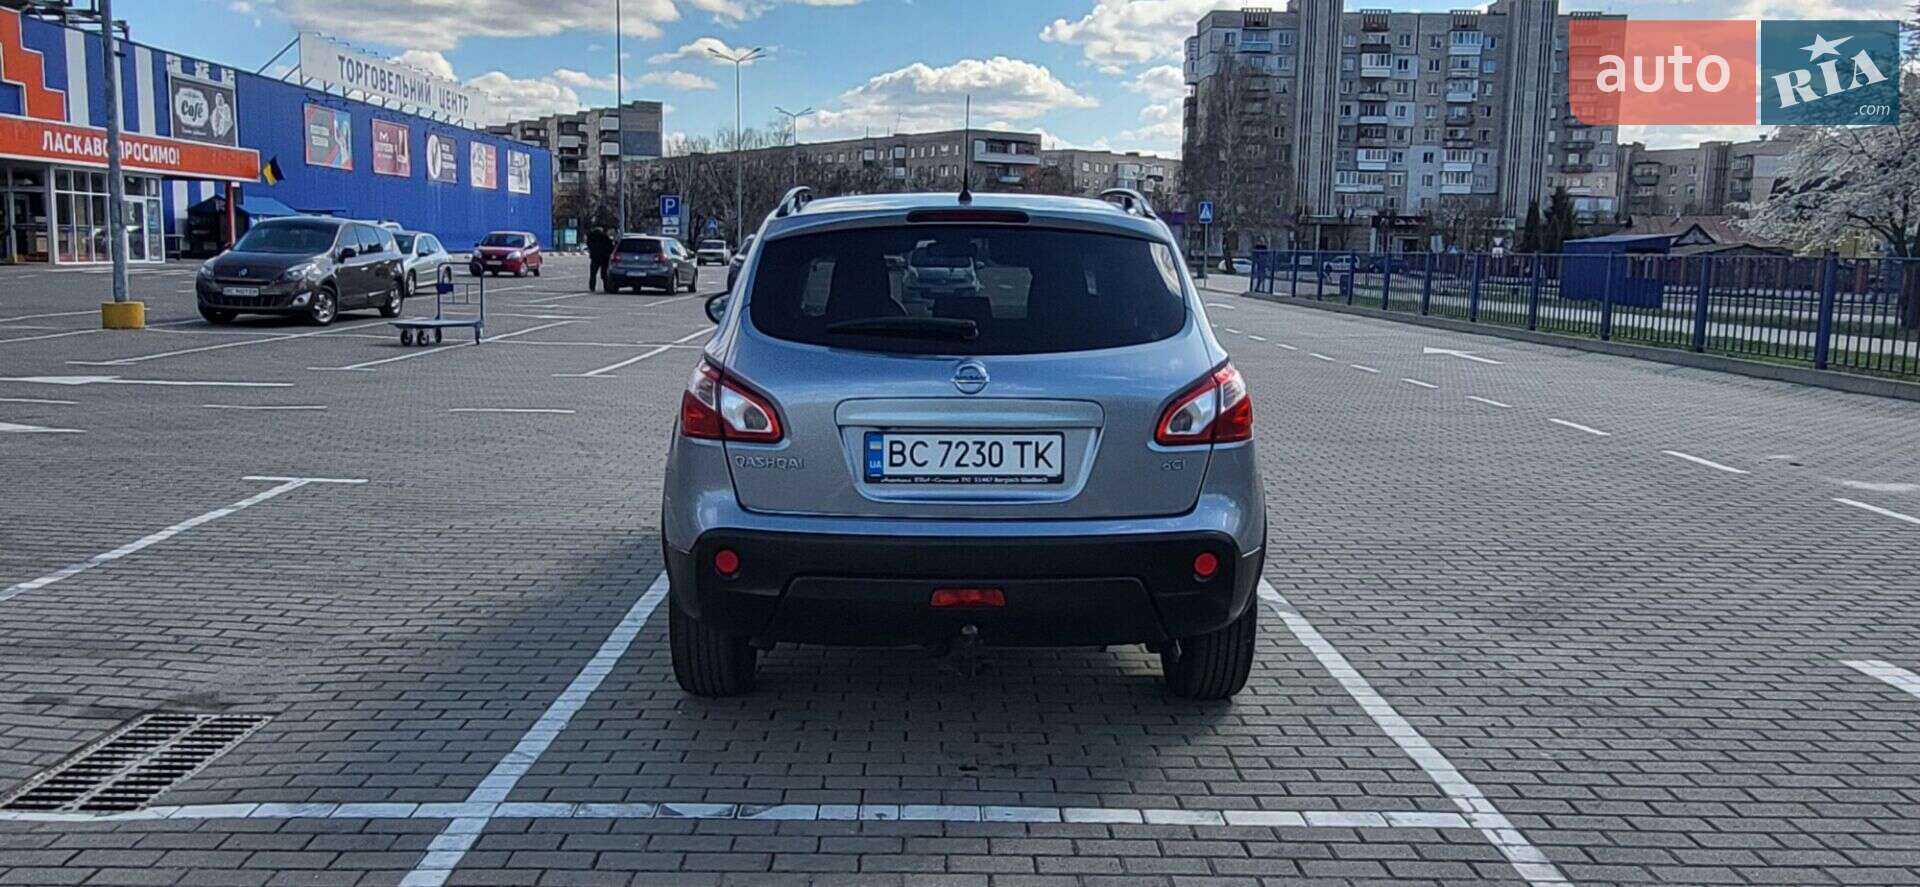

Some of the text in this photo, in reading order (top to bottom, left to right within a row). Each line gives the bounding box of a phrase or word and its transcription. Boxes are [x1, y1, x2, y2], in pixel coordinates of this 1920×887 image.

[337, 54, 469, 115] ТОРГОВЕЛЬНИЙ ЦЕНТР
[665, 198, 676, 215] P
[869, 460, 882, 469] UA
[888, 441, 1054, 468] BC 7230 TK
